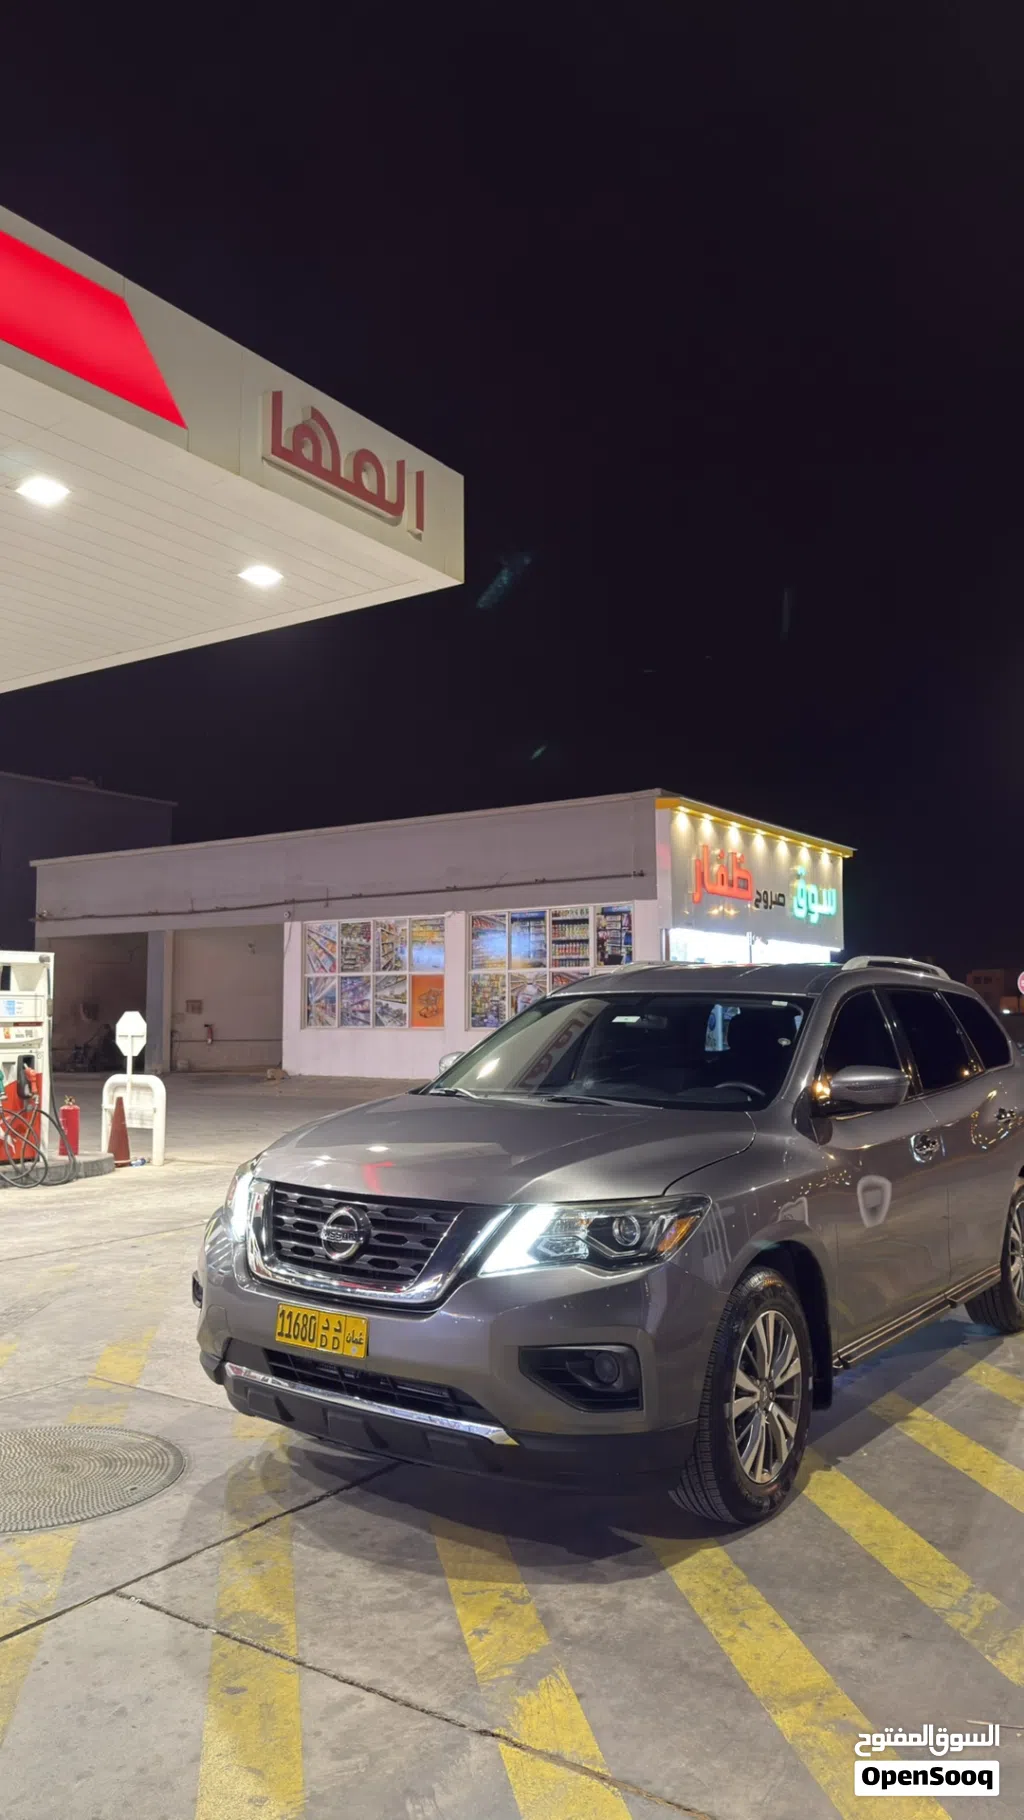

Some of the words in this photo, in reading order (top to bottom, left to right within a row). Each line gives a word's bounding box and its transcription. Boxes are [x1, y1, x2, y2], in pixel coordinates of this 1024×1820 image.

[270, 390, 425, 532] المها
[691, 844, 754, 905] ظفار
[792, 862, 837, 924] سوق
[277, 1309, 317, 1343] 11680
